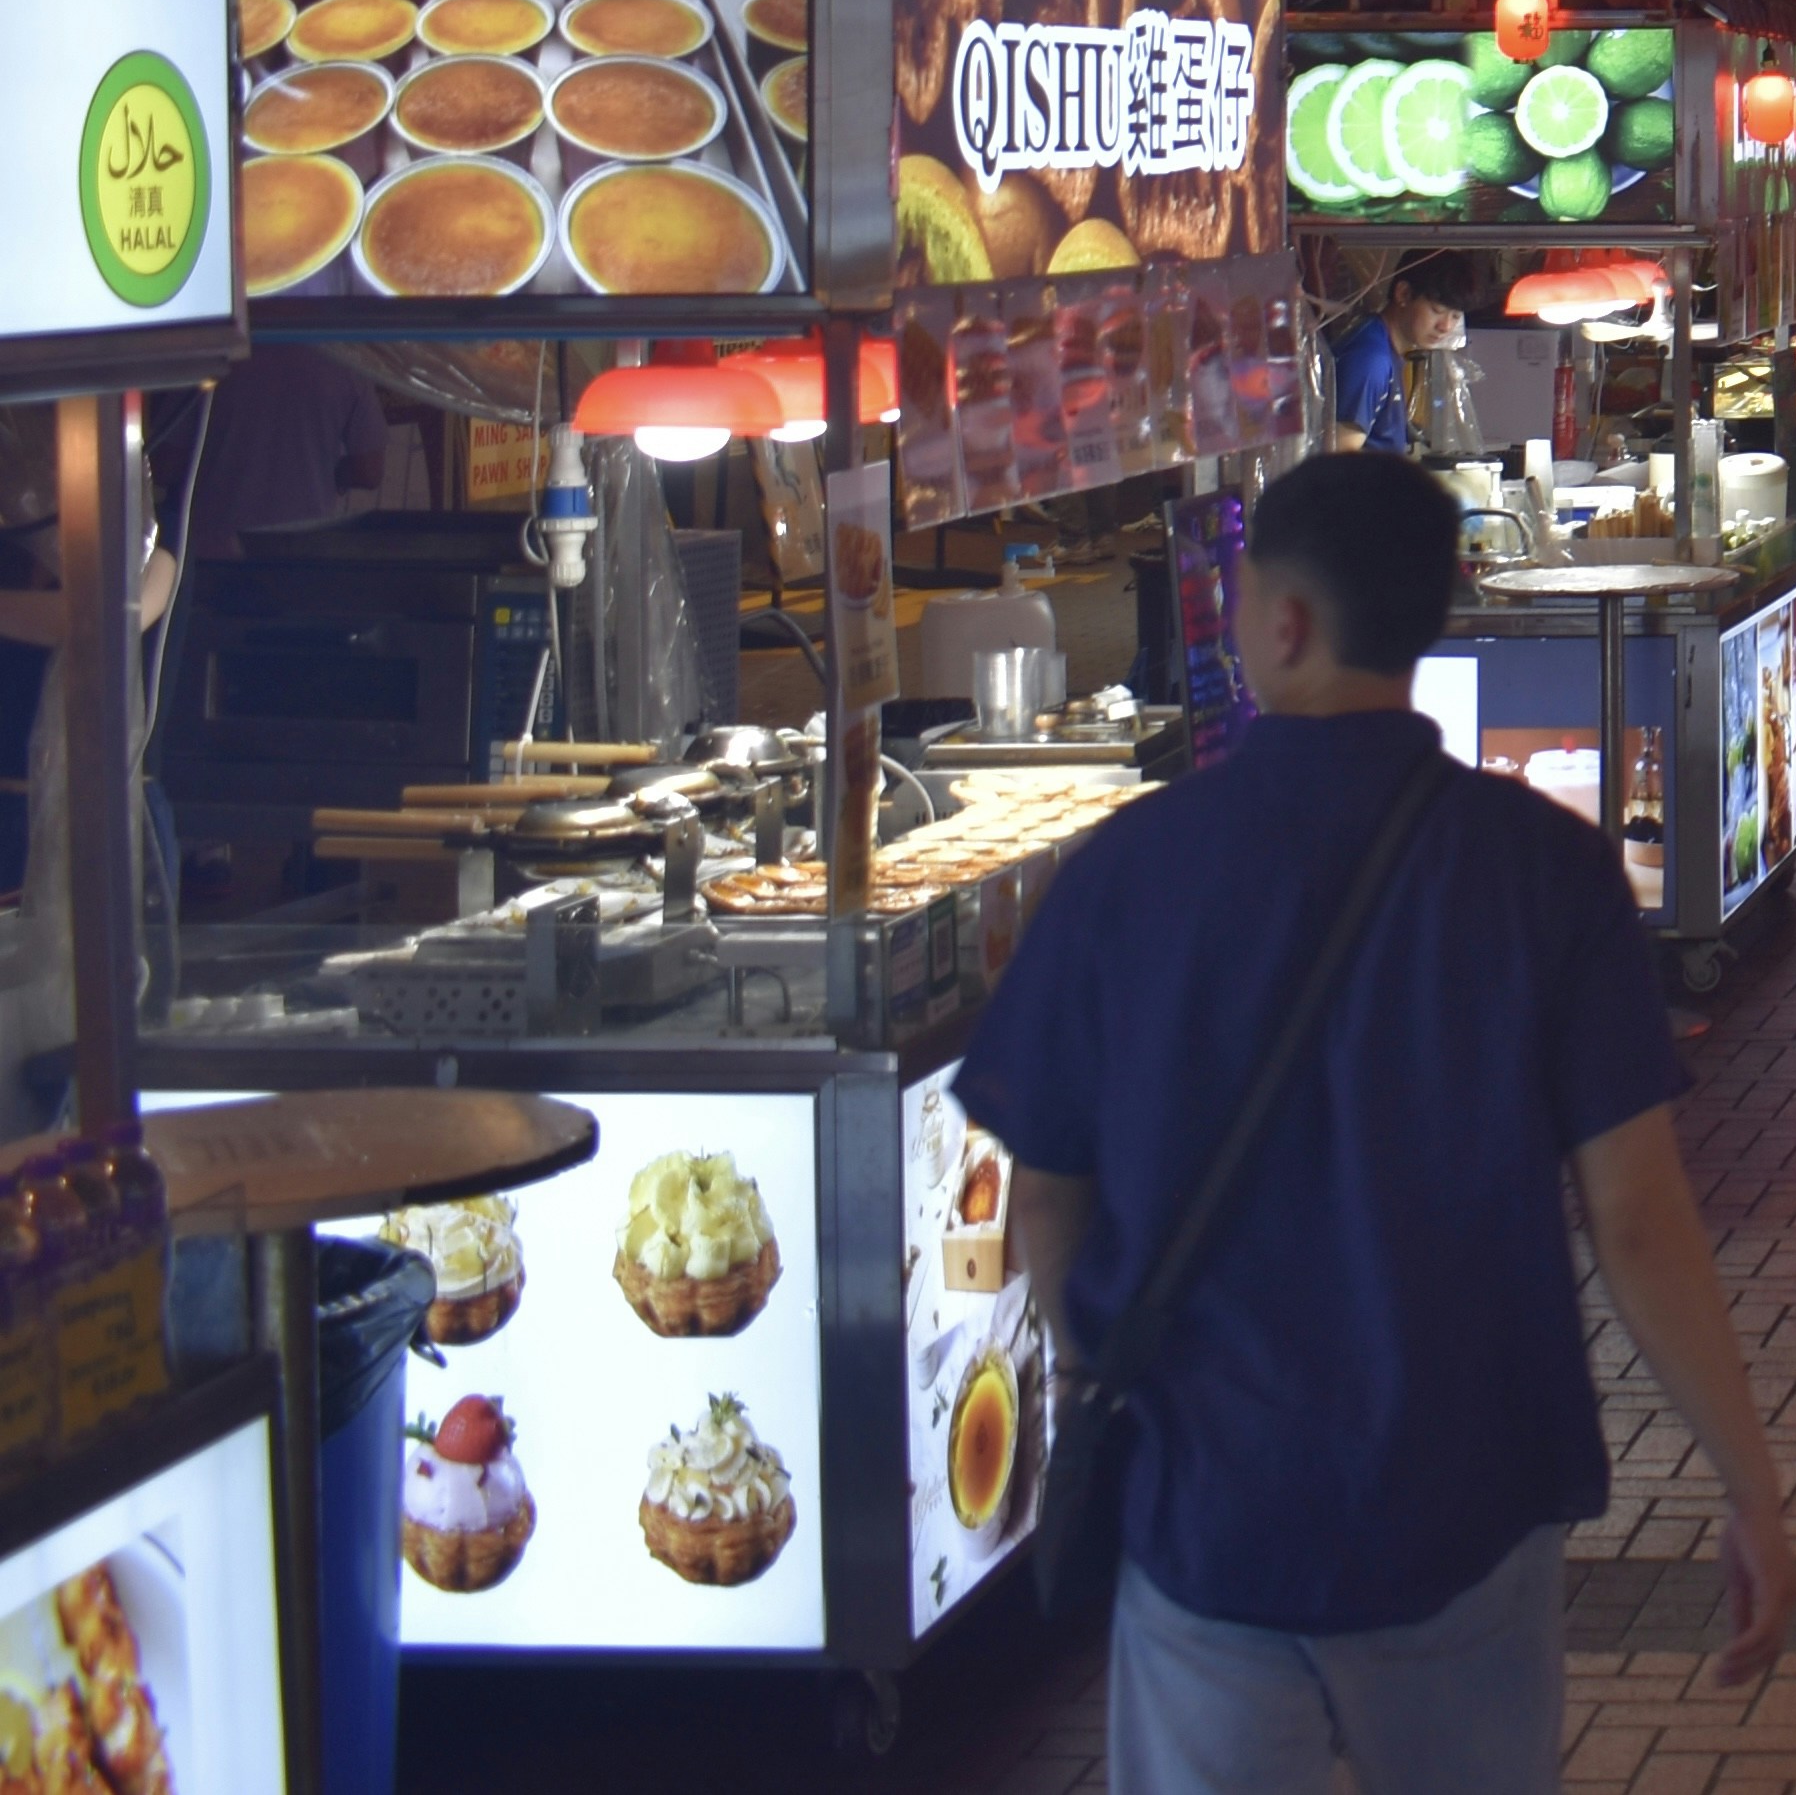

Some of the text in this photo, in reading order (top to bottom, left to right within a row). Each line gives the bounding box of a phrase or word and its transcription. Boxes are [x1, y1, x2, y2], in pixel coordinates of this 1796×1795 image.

[960, 24, 1251, 178] QISHU 雞蛋仔
[107, 103, 184, 180] حلال
[129, 185, 163, 218] 清真
[120, 225, 176, 252] HALAL
[475, 422, 547, 448] MING SA
[473, 455, 547, 487] PAWN SHP
